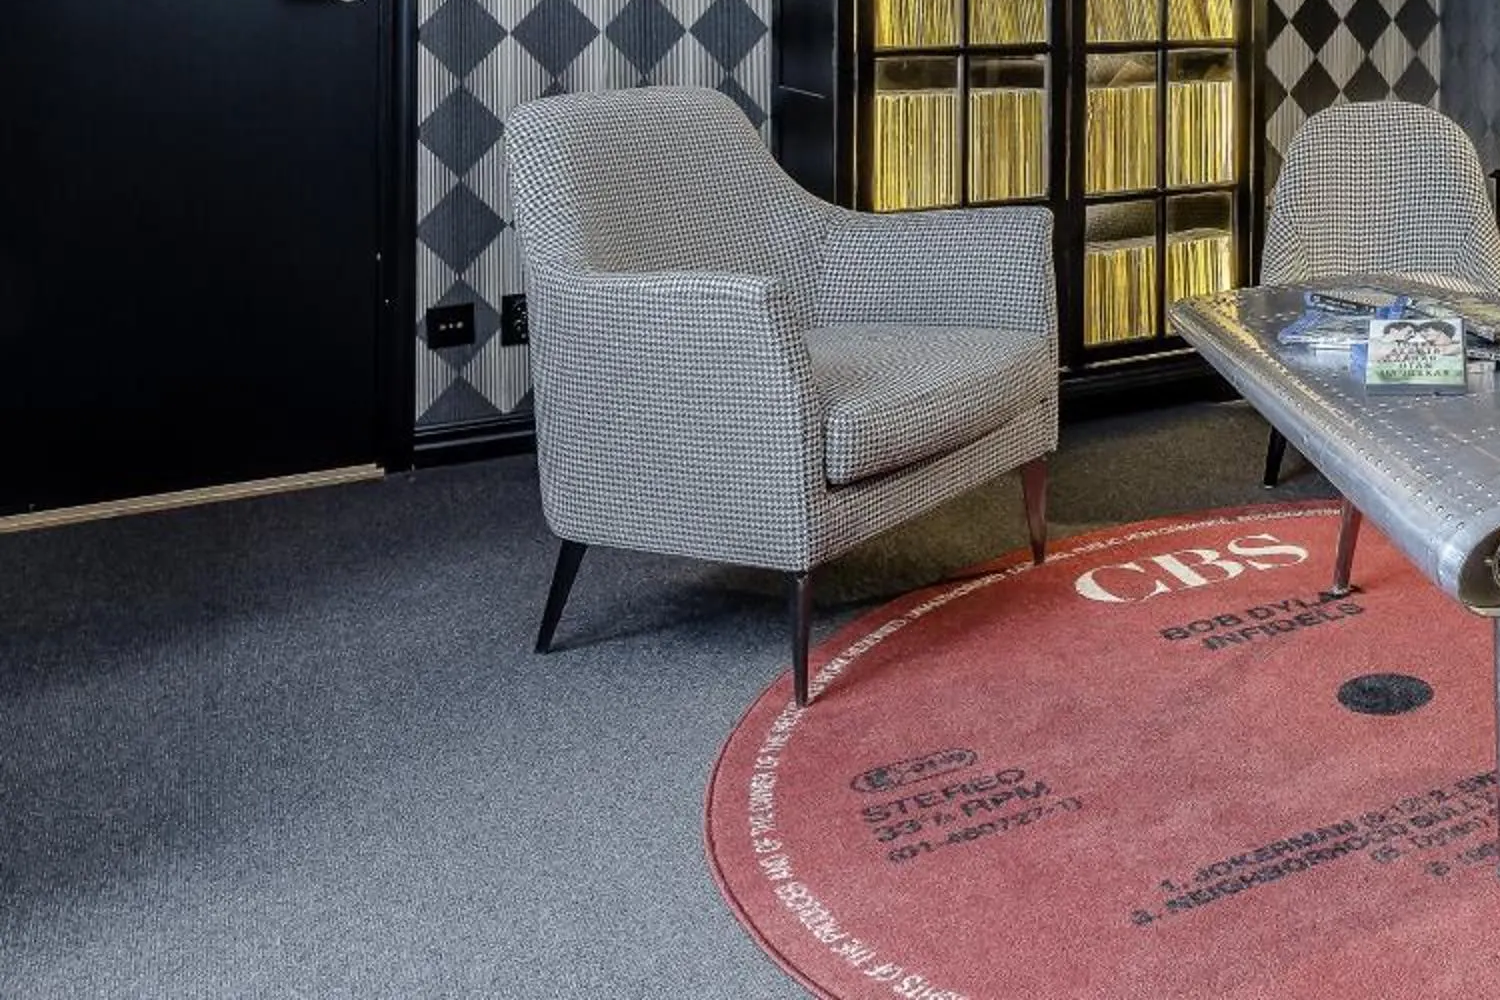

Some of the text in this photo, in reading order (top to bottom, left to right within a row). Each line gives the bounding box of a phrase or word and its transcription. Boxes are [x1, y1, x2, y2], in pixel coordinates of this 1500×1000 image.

[1074, 533, 1309, 602] CBS
[1160, 613, 1243, 641] BOB
[1202, 602, 1365, 650] INFIDELS
[861, 768, 1026, 824] STEREO
[960, 781, 1051, 818] RPM
[1194, 819, 1358, 882] JOKERMAN
